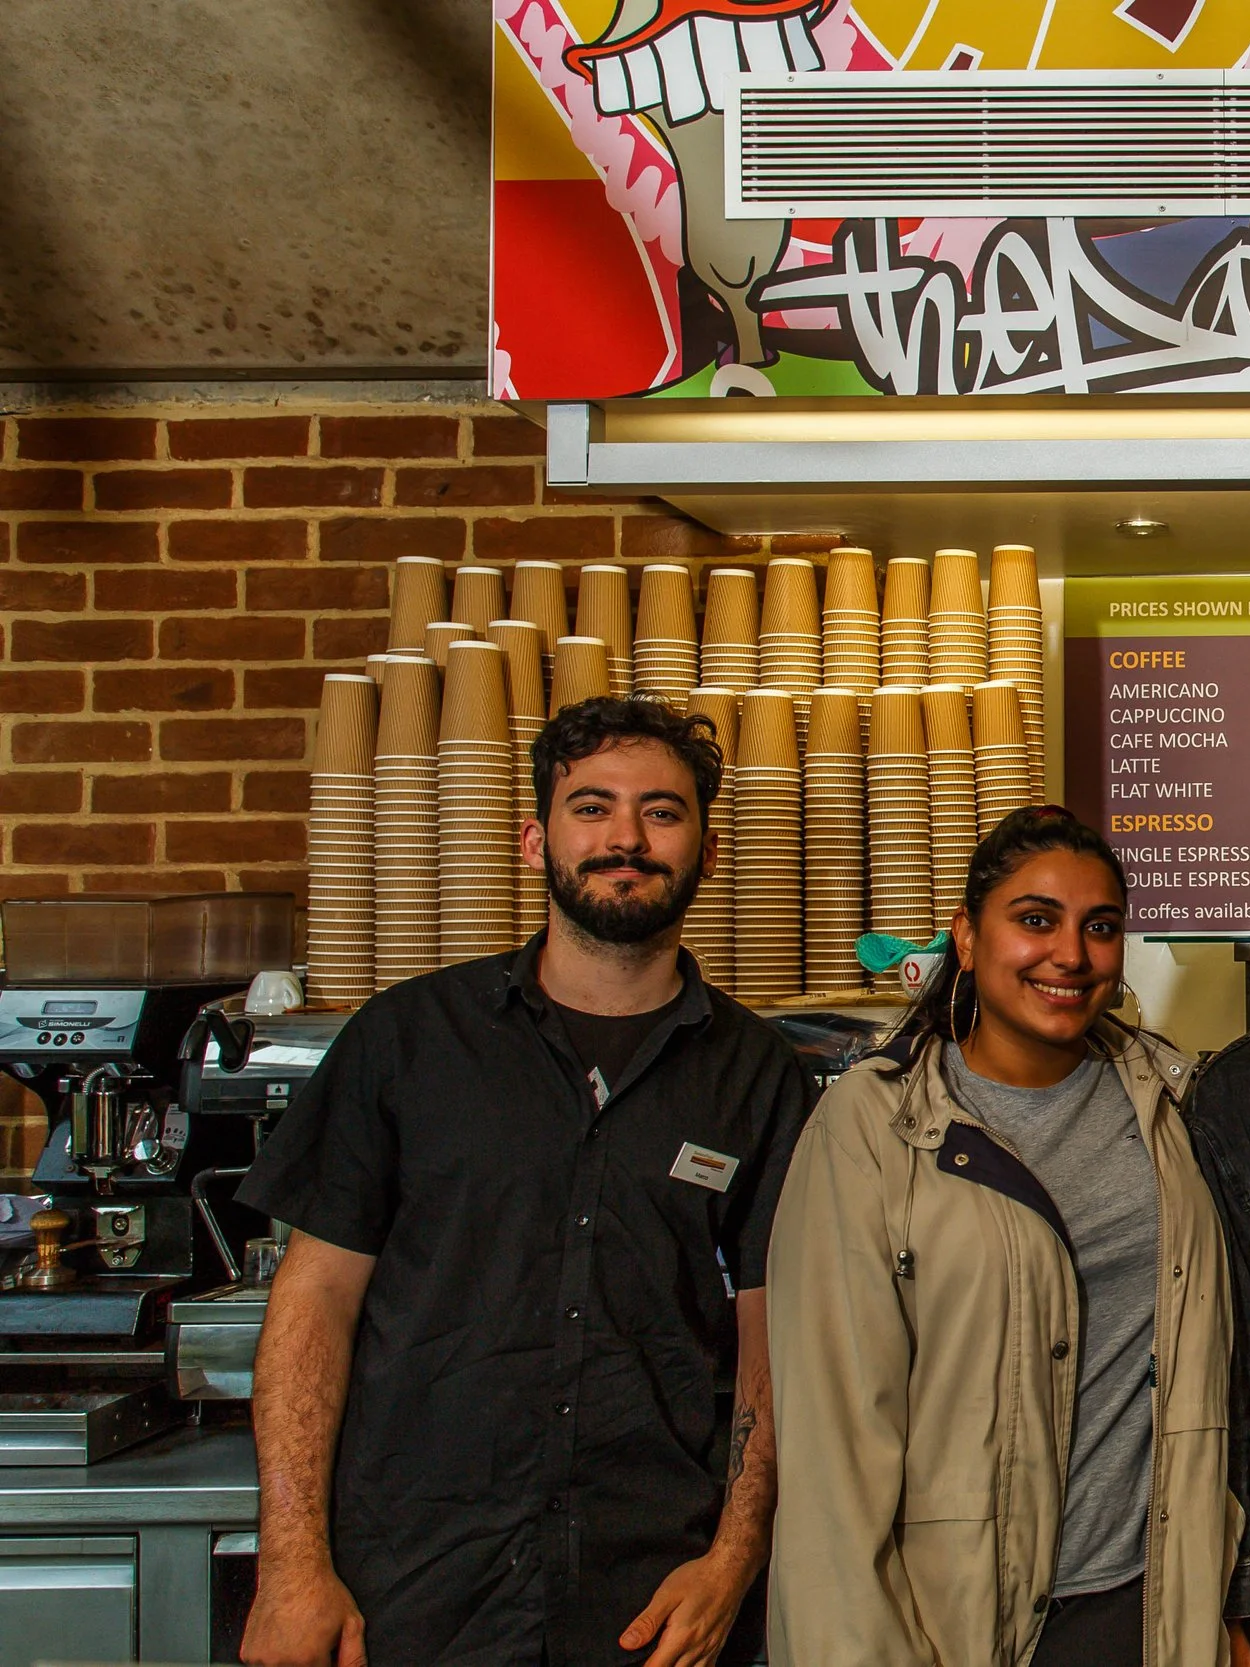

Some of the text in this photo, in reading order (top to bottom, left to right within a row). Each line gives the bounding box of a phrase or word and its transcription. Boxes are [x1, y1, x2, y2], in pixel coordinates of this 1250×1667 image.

[1109, 601, 1169, 617] PRICES
[1173, 601, 1243, 617] SHOWN
[1109, 650, 1186, 669] COFFEE
[1109, 682, 1219, 699] AMERICANO
[1110, 707, 1225, 724] CAPPUCCINO
[1110, 733, 1154, 749] CAFE
[1159, 732, 1229, 749] MOCHA
[1111, 758, 1161, 774] LATTE
[1111, 782, 1213, 799] FLAT WHITE
[1111, 813, 1214, 833] ESPRESSO
[1111, 847, 1172, 863] SINGLE
[1126, 872, 1182, 888] OUBLE
[1138, 902, 1189, 919] coffes
